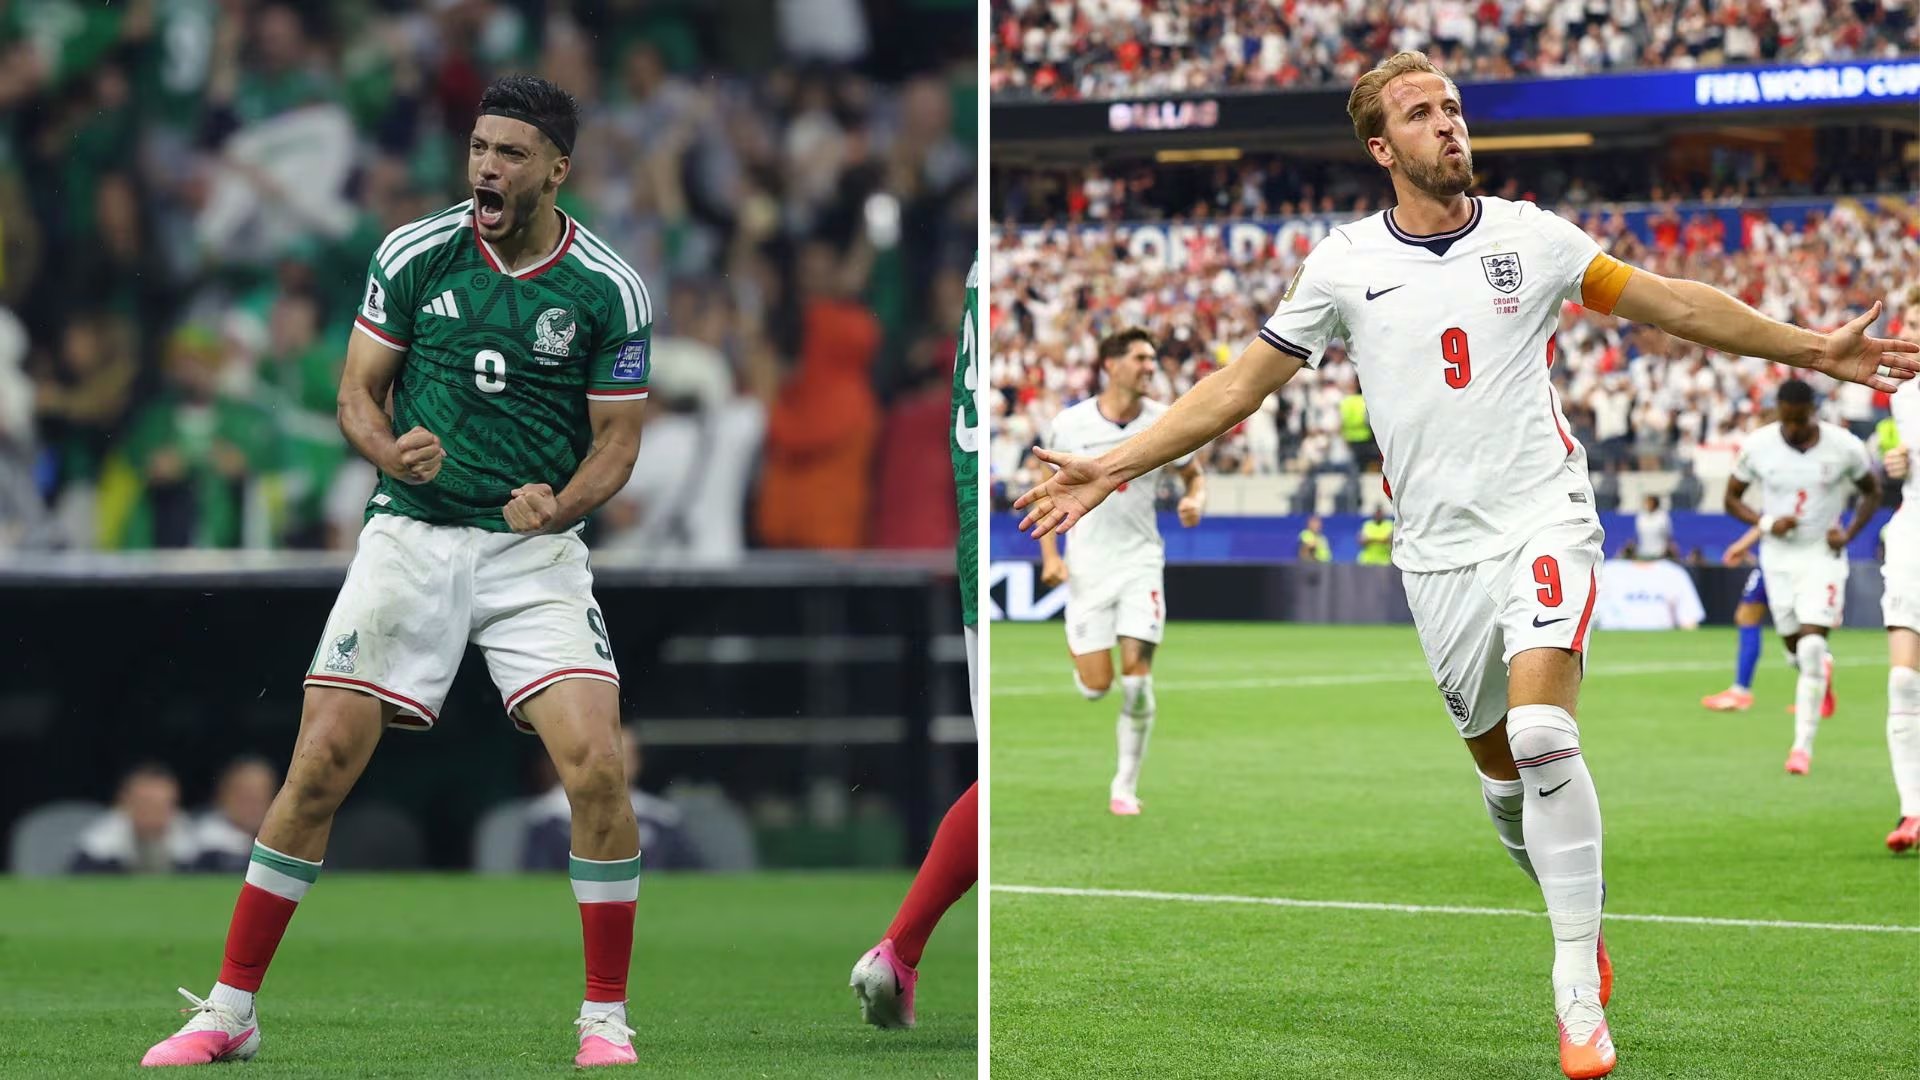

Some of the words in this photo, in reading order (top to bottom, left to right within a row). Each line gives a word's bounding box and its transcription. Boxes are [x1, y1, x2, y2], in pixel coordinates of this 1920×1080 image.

[1695, 72, 1760, 105] FIFA
[1757, 65, 1866, 102] WORLD
[1866, 62, 1919, 97] CUP
[1493, 296, 1520, 305] CROATIA
[533, 342, 568, 356] MÉXICO
[1440, 327, 1472, 389] 9
[1794, 489, 1808, 517] 2
[1532, 554, 1563, 608] 9
[1826, 584, 1838, 608] 2
[586, 607, 613, 661] 9
